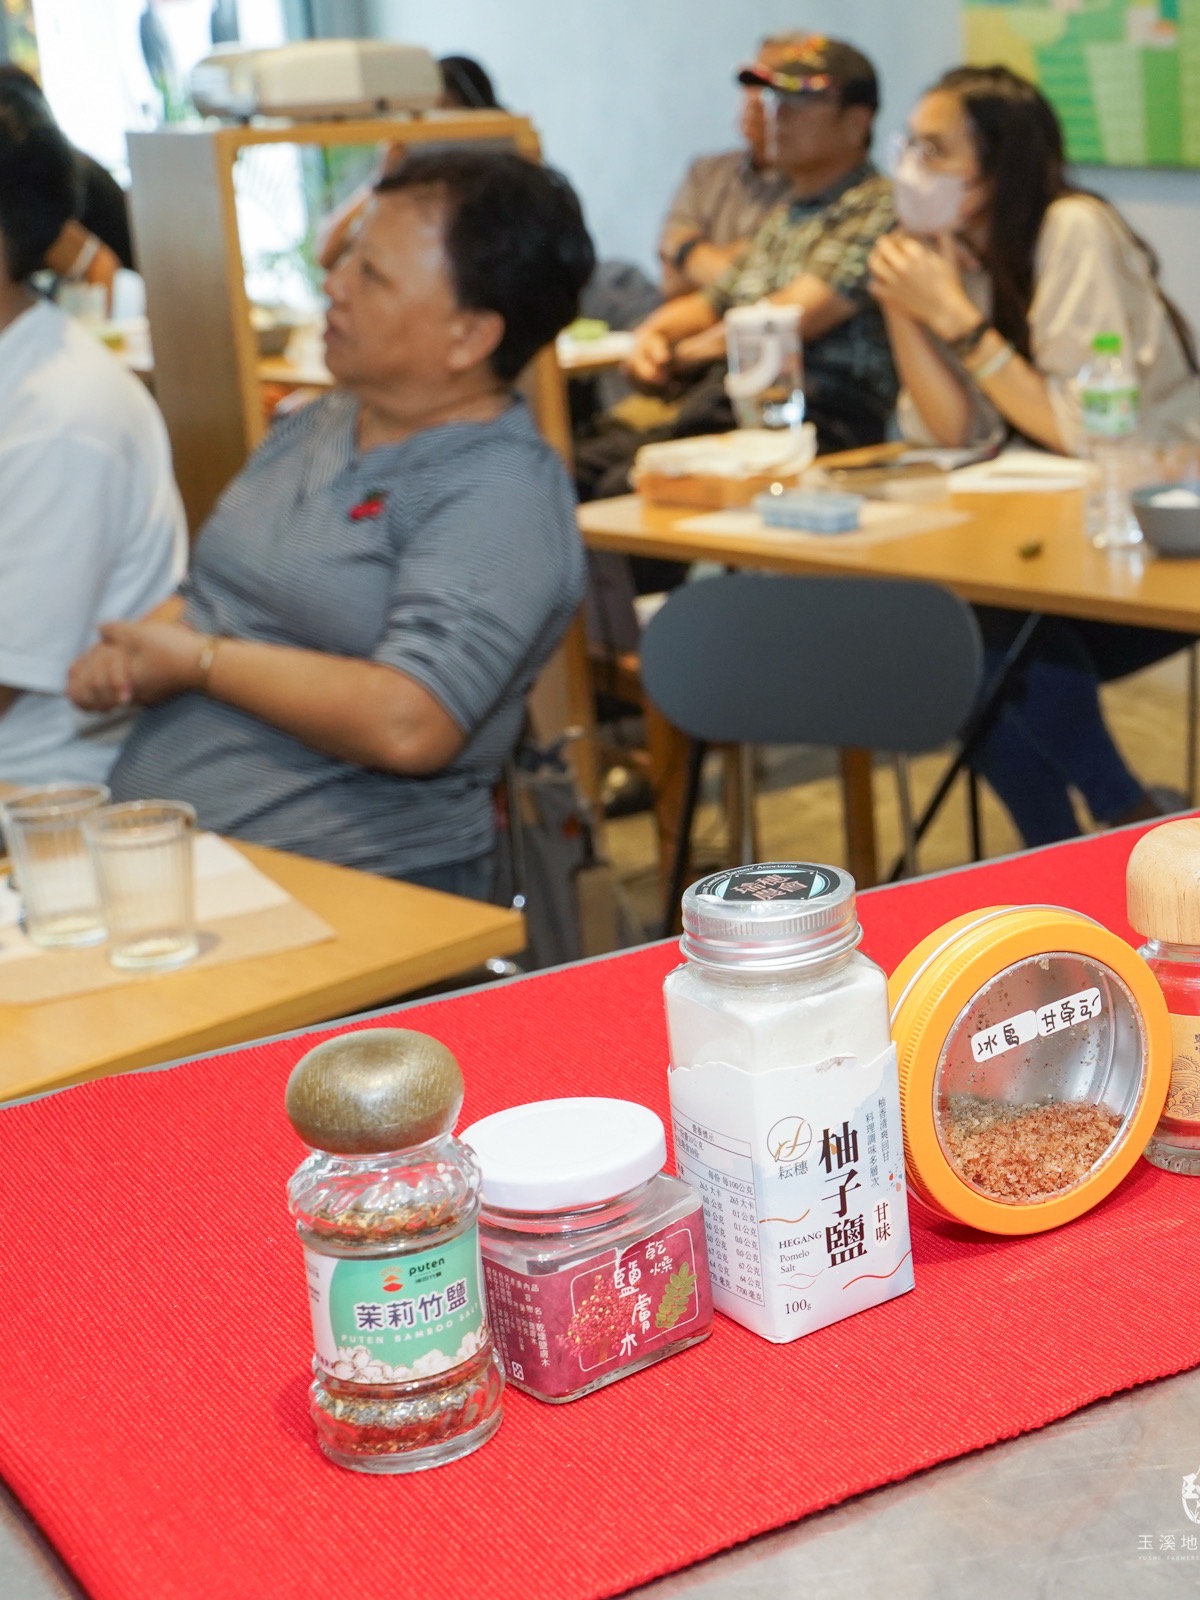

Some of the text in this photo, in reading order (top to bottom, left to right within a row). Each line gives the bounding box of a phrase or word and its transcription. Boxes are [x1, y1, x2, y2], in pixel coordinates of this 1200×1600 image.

[818, 1121, 867, 1268] 柚子鹽
[874, 1202, 891, 1243] 甘味
[779, 1231, 822, 1249] HEGANG
[409, 1258, 445, 1276] puten
[645, 1240, 673, 1276] 乾燥
[779, 1249, 810, 1263] Pomelo
[780, 1263, 796, 1274] Salt
[356, 1280, 467, 1329] 茉莉竹鹽
[613, 1260, 652, 1357] 鹽膚木
[785, 1299, 812, 1315] 100g
[341, 1334, 384, 1344] PUTEN
[395, 1320, 453, 1342] BAMBOO
